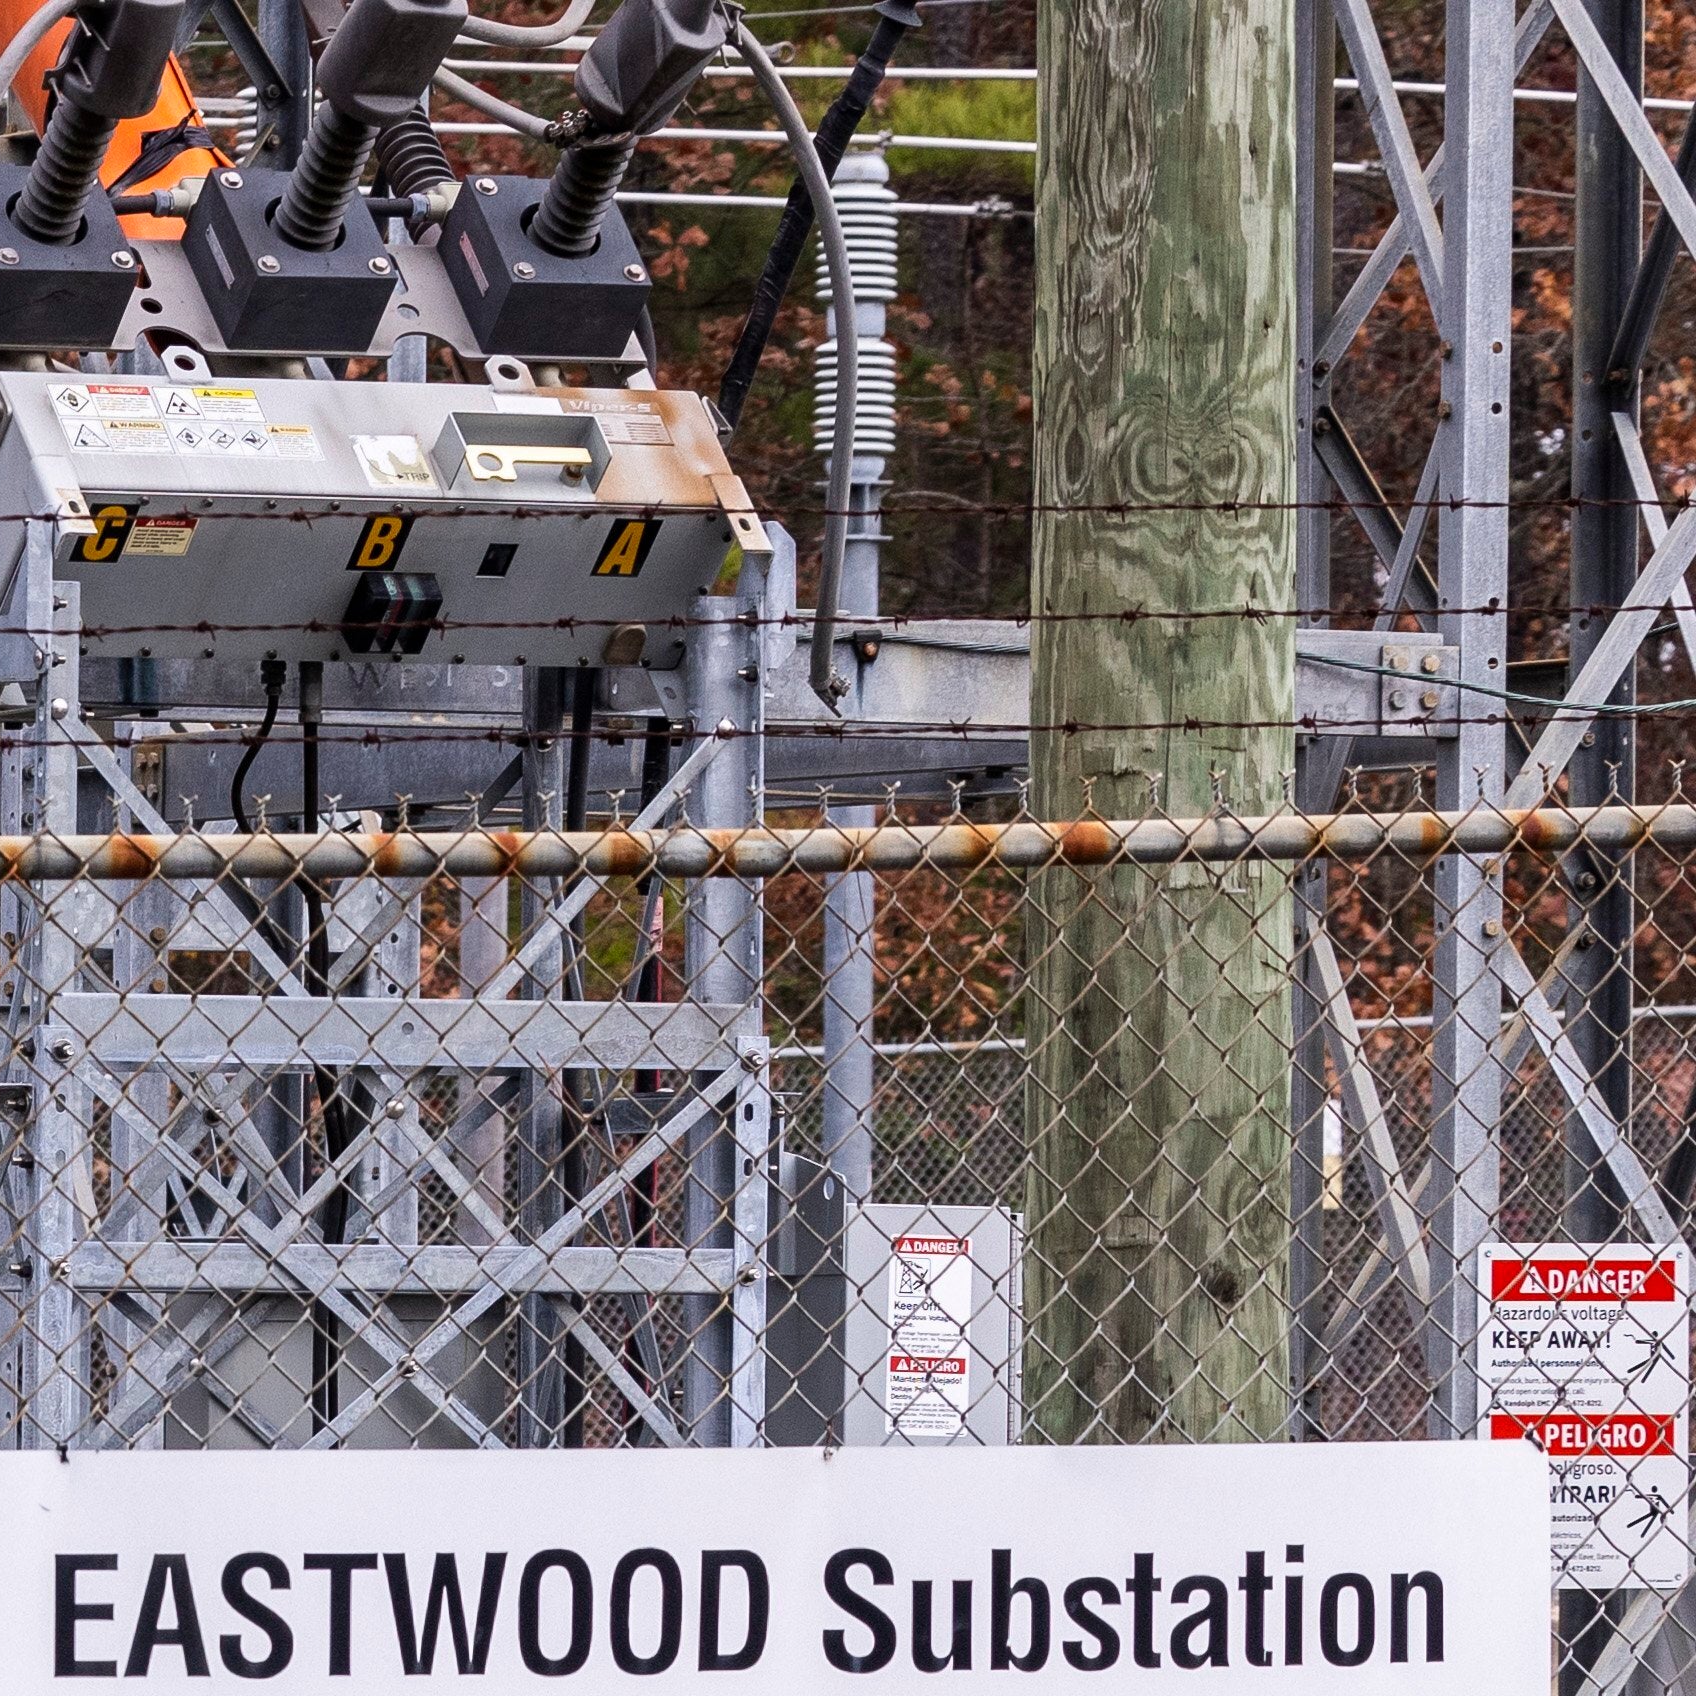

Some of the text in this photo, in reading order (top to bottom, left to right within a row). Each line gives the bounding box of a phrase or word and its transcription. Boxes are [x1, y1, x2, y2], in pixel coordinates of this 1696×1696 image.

[569, 400, 651, 413] Viper-S
[83, 506, 127, 560] C
[356, 517, 402, 567] B
[597, 522, 645, 574] A
[1548, 1269, 1647, 1294] DANGER
[1492, 1331, 1612, 1348] KEEP AWAY!
[1545, 1423, 1647, 1448] PELIGRO
[55, 1545, 1443, 1679] EASTWOOD Substation
